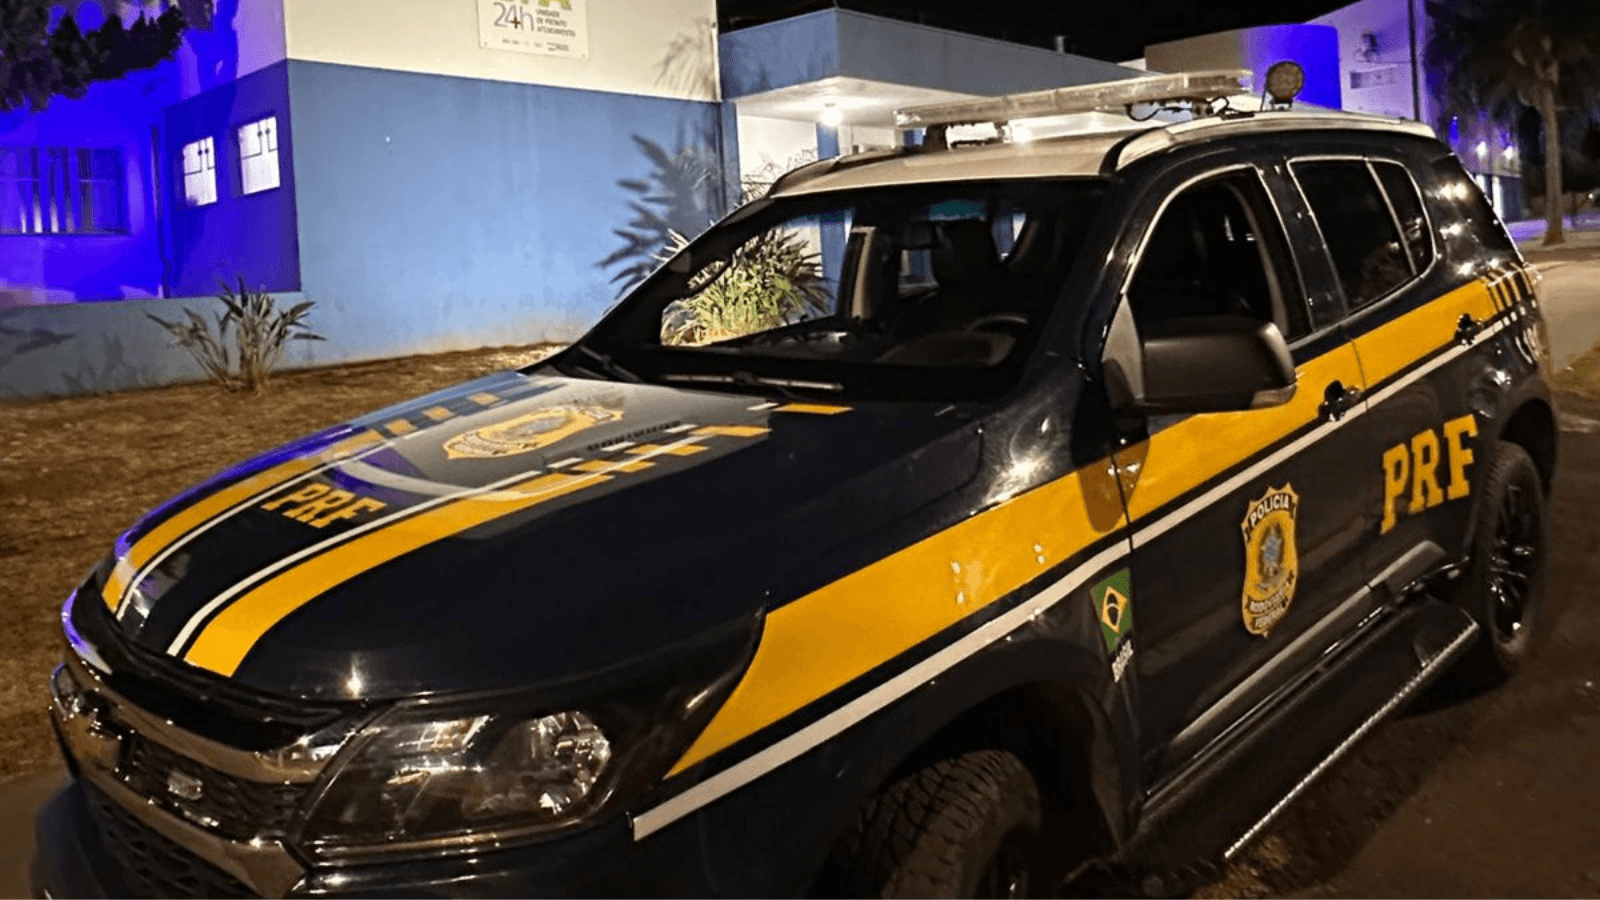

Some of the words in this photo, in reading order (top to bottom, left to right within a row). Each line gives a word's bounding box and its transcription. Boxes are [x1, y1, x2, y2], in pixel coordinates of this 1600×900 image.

[493, 2, 534, 31] 24h
[1380, 413, 1478, 535] PRF
[260, 482, 388, 529] PRF
